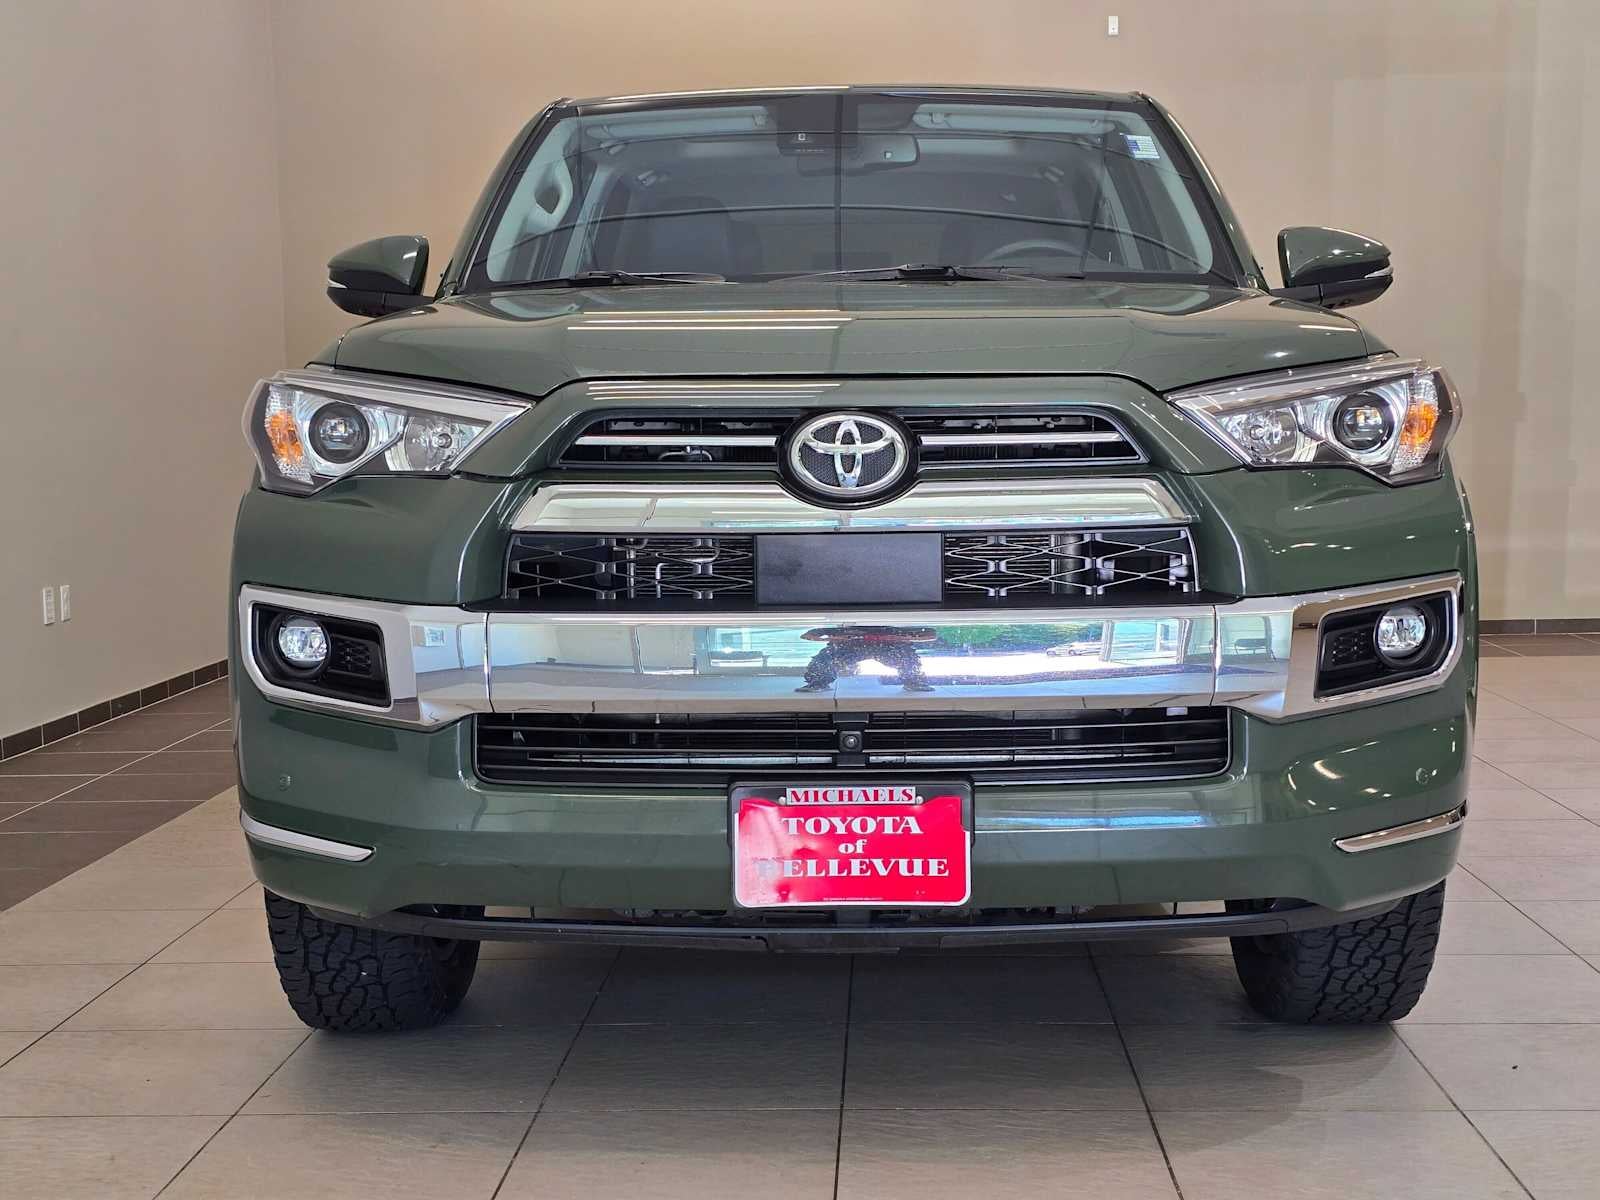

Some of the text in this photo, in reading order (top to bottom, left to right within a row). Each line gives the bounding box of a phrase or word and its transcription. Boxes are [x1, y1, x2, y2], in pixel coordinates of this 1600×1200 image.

[790, 788, 913, 803] MICHAELS
[782, 816, 923, 835] TOYOTA
[838, 839, 867, 854] of
[758, 858, 949, 877] ELLEVUE
